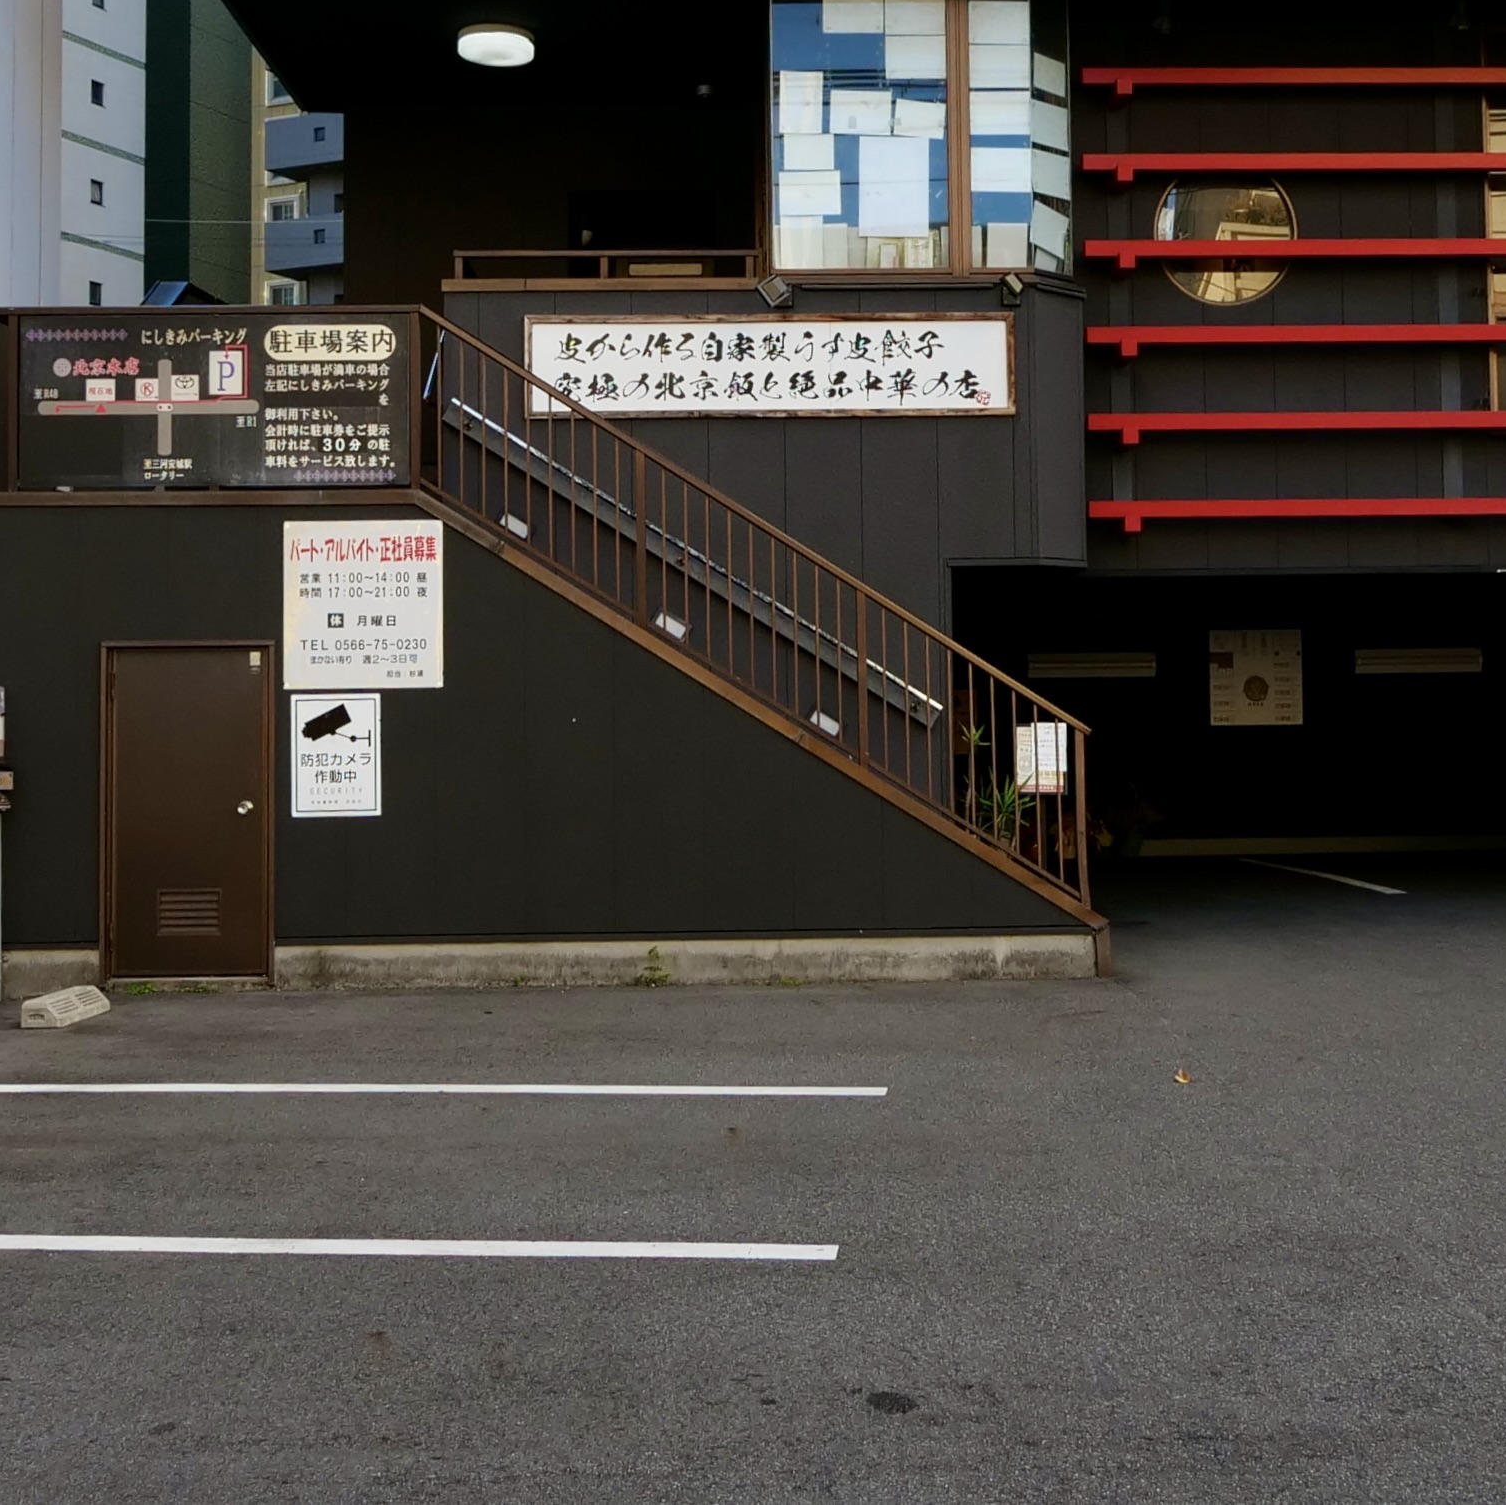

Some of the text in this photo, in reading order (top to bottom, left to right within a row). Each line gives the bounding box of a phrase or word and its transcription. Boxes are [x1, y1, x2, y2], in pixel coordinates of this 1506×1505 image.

[141, 328, 247, 345] にしきみパーキング
[269, 329, 394, 354] 駐車場案内
[554, 331, 945, 366] 皮から作る自家製うす皮餃子
[72, 356, 140, 377] 北京本店
[264, 363, 390, 377] 当店駐車場が満車の場合
[216, 360, 236, 392] P
[264, 379, 390, 393] 左記にしきみパーキング
[378, 394, 390, 406] を
[264, 408, 339, 421] 御利用下さい。
[264, 424, 390, 437] 会計時に駐車券をご提示
[264, 455, 395, 469] 車料をサービス致します。
[144, 470, 185, 481] ロータリー
[299, 572, 322, 584] 営業
[416, 572, 427, 583] 昼
[299, 587, 322, 599] 時間
[416, 586, 428, 598] 夜
[330, 614, 397, 627] 休 月曜日
[300, 639, 427, 651] TEL 0566-75-0230
[300, 753, 372, 768] 防犯カメラ
[315, 769, 357, 784] 作動中
